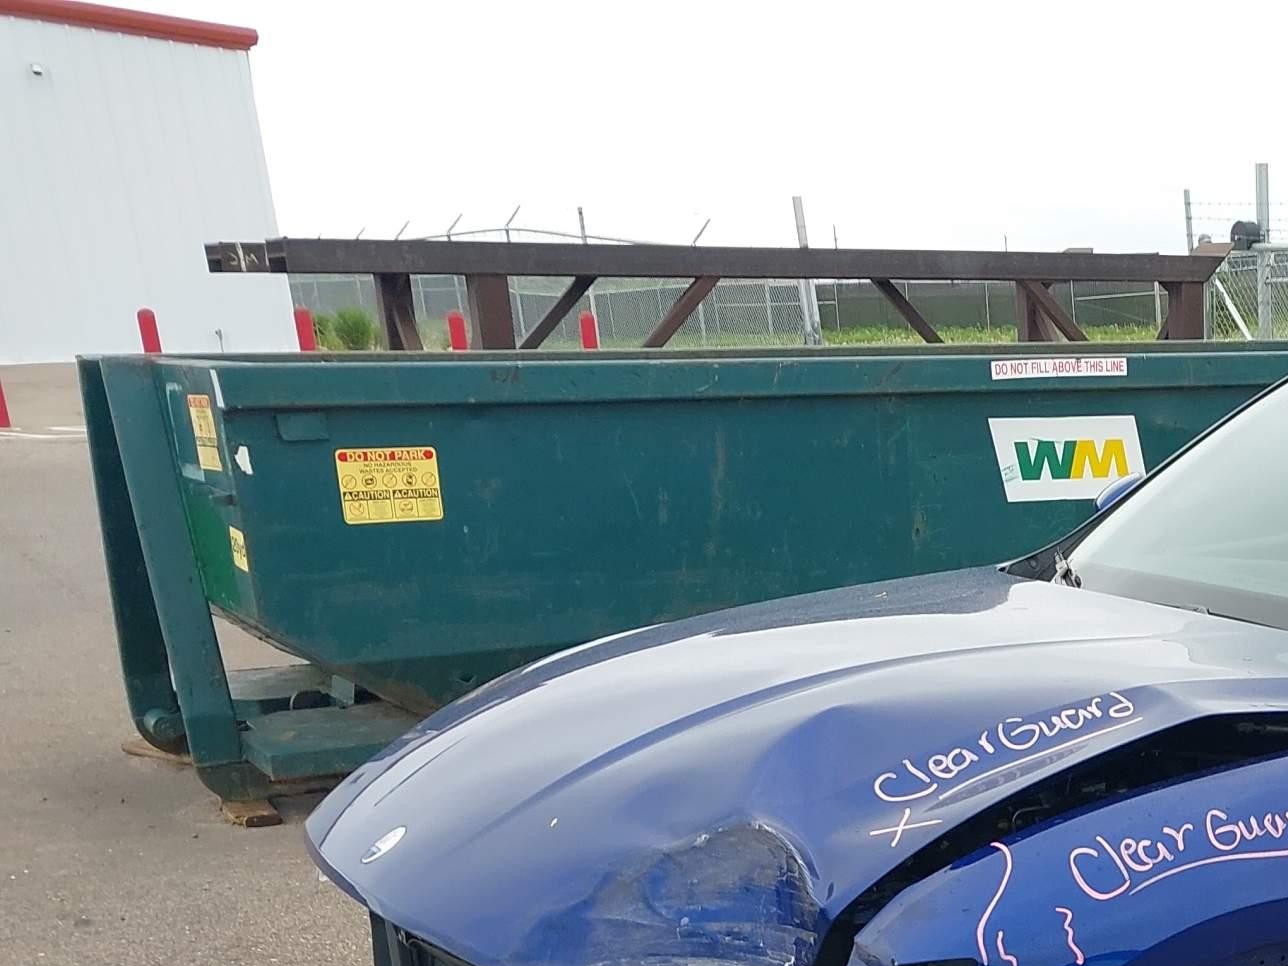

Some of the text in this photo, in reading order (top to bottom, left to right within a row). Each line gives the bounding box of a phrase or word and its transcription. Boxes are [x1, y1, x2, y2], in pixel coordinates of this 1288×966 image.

[995, 360, 1125, 376] DO NOT FILL ABOVE THIS LINE
[346, 449, 426, 463] DO NOT PARK
[1013, 438, 1130, 481] WM
[352, 490, 391, 500] CAUTION
[401, 488, 439, 499] CAUTION
[1069, 823, 1194, 900] Clear
